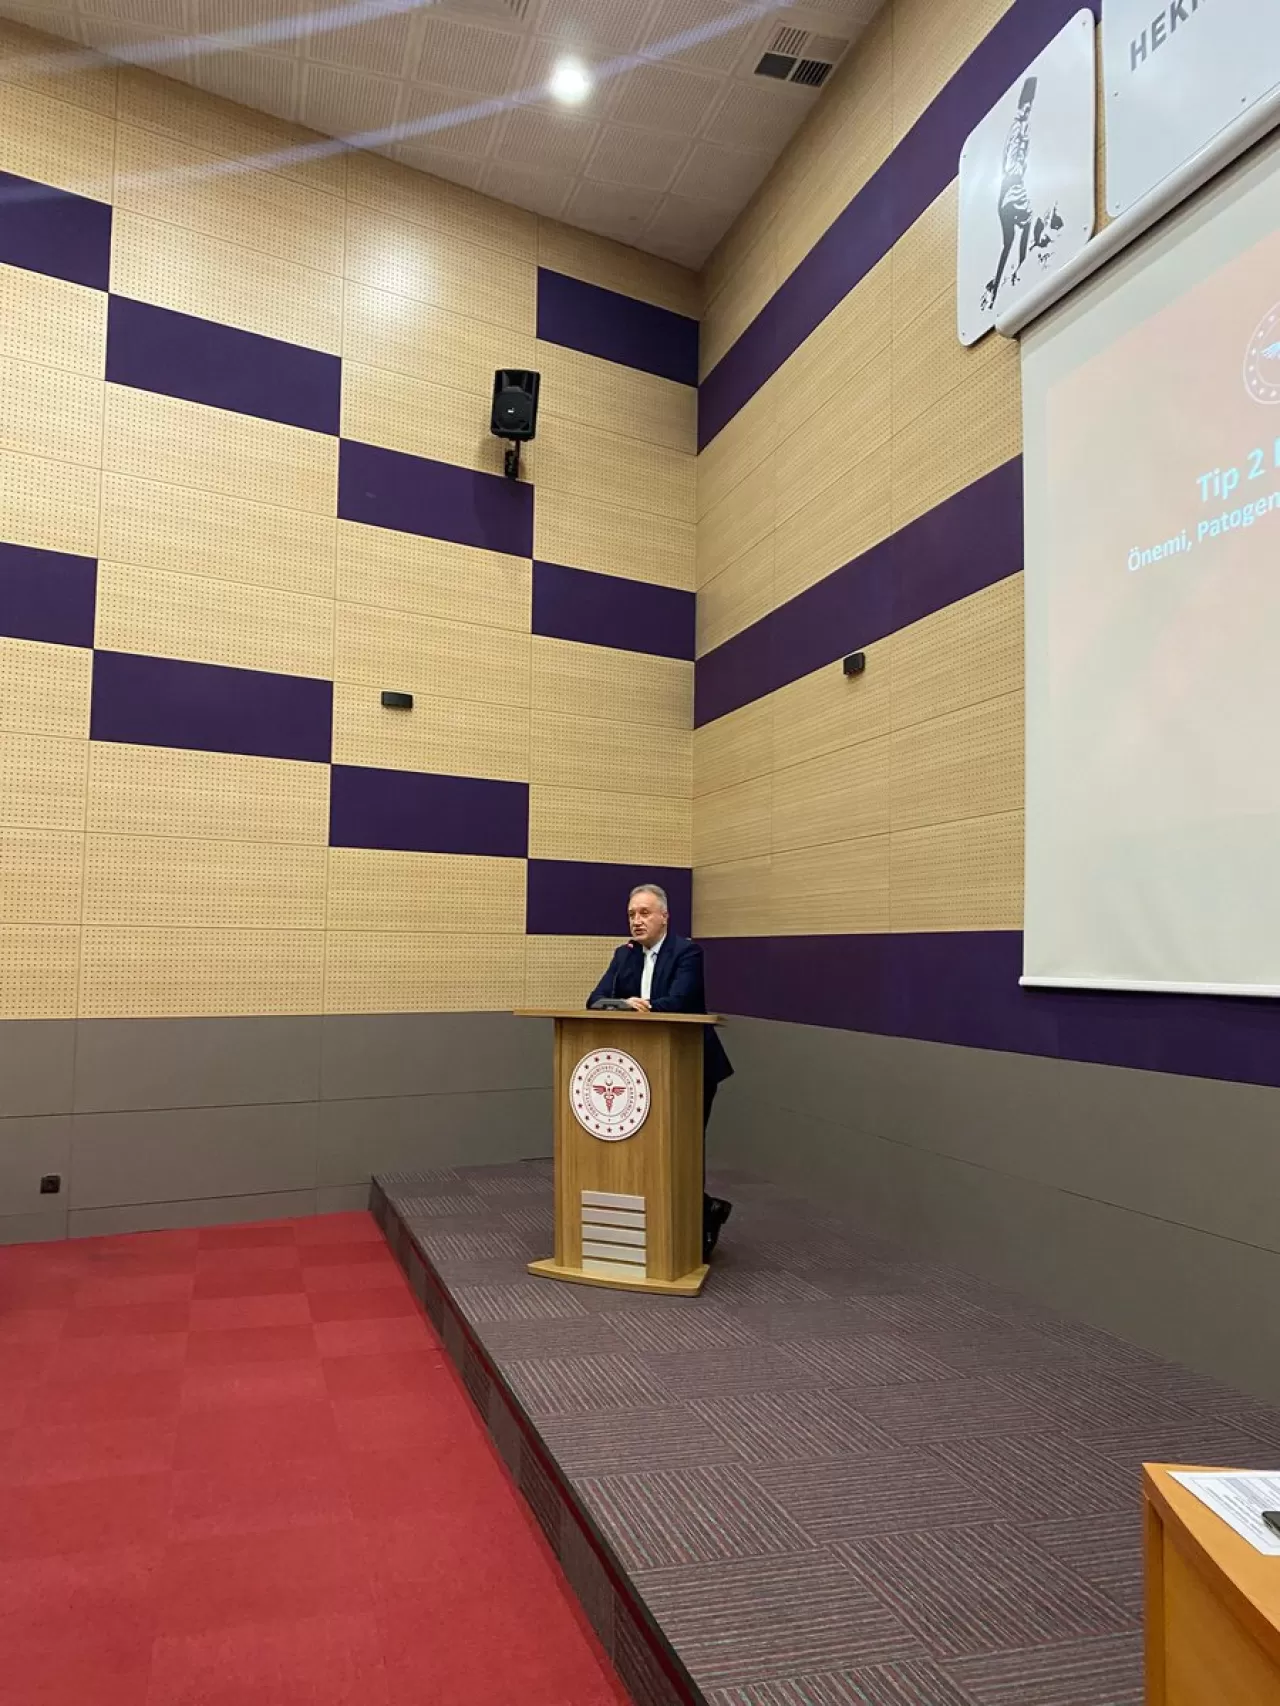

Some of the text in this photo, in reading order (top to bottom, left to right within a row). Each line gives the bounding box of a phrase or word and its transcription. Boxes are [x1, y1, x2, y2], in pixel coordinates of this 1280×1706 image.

[1196, 467, 1239, 503] Tip
[1247, 447, 1266, 480] 2
[1128, 491, 1280, 571] Önemi, Patogen
